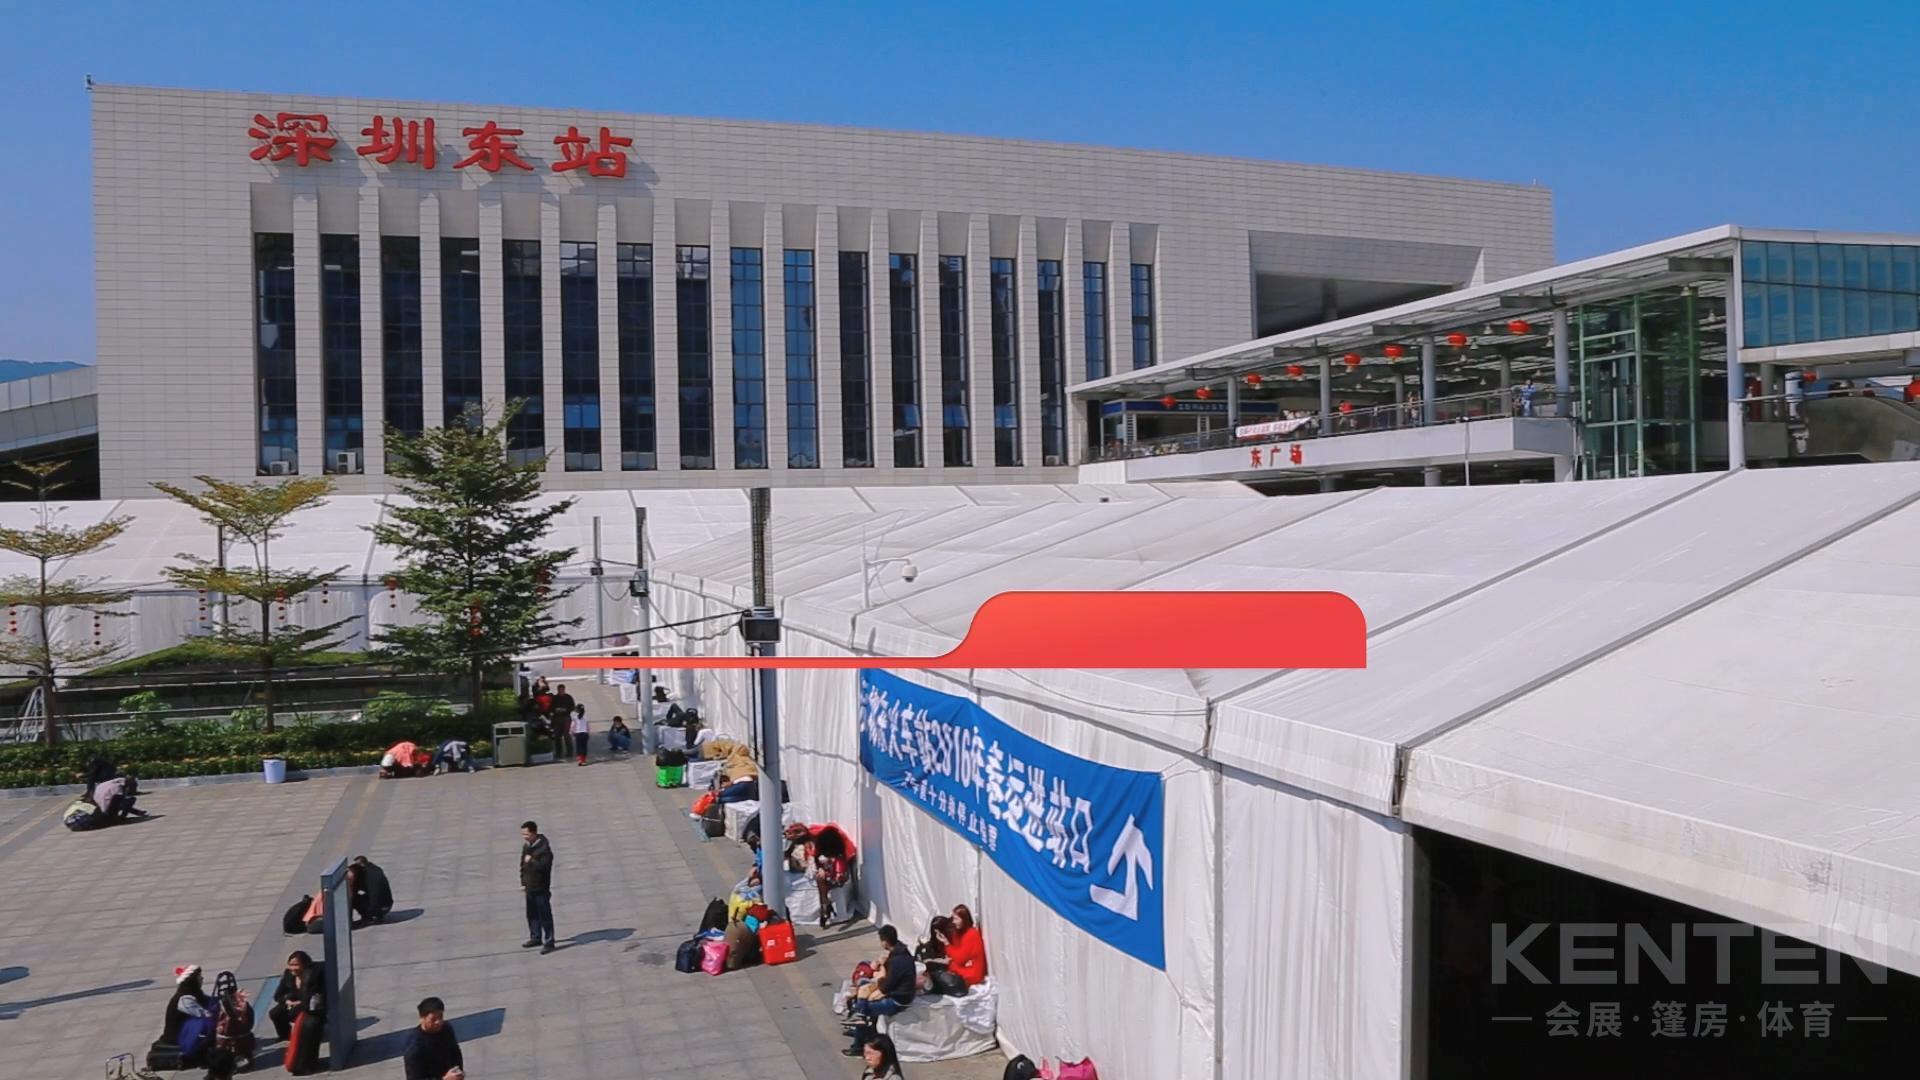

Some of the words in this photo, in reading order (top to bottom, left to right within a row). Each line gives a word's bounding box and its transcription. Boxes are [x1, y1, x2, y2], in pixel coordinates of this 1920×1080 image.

[247, 112, 633, 178] 深圳东站
[1251, 444, 1303, 468] 东广场
